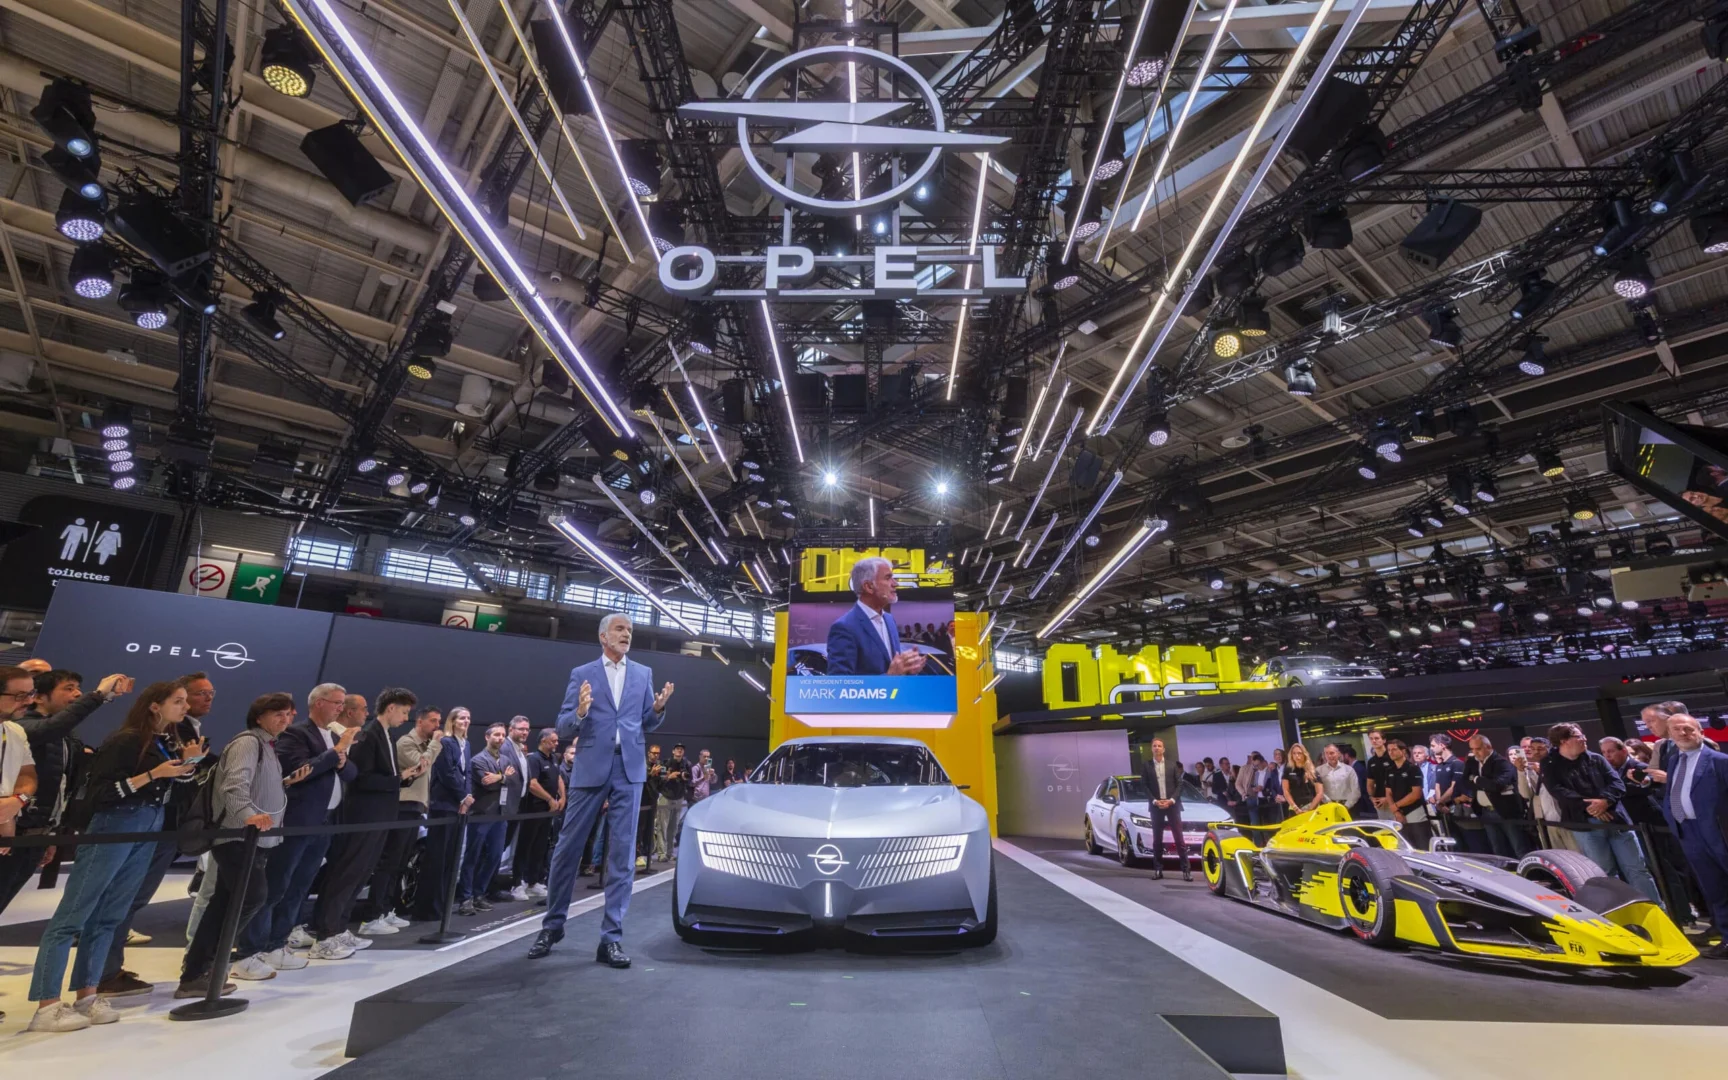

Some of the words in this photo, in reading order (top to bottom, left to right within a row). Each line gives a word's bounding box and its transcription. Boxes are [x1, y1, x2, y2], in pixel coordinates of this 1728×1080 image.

[658, 245, 1027, 294] OPEL
[47, 567, 110, 582] toilettes
[126, 643, 200, 657] OPEL
[800, 689, 836, 699] MARK
[840, 688, 887, 699] ADAMS
